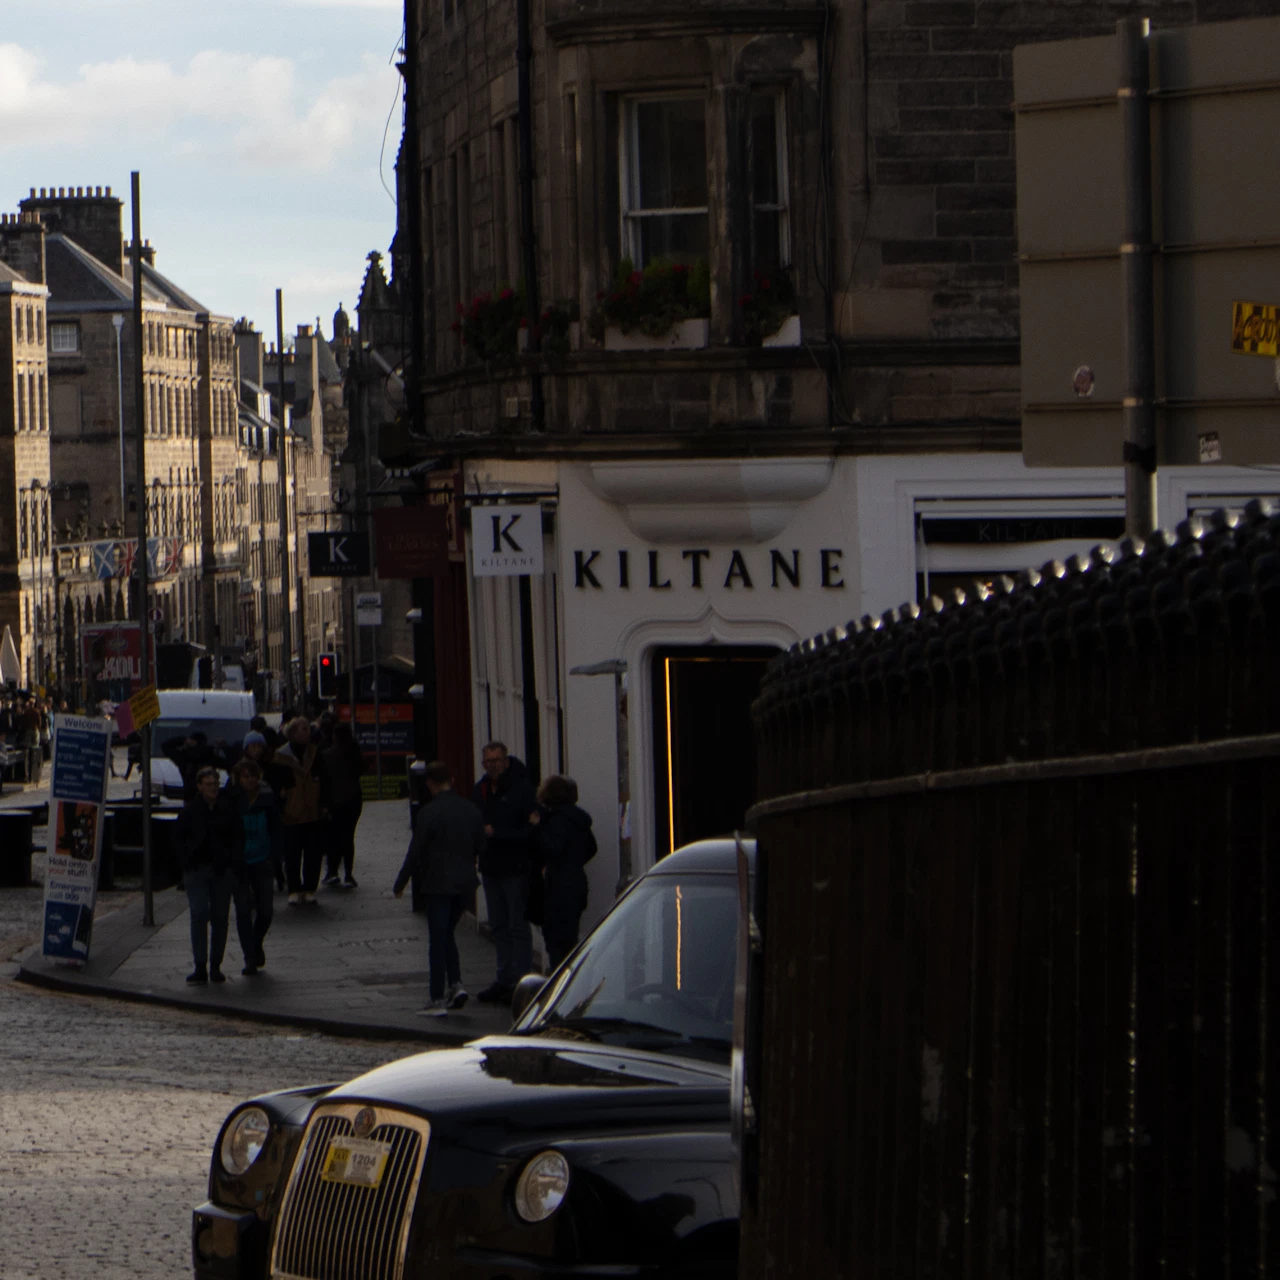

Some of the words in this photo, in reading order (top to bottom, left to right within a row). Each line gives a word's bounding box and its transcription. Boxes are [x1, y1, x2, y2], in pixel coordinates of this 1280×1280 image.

[491, 514, 523, 552] K
[328, 536, 350, 563] K
[481, 557, 535, 567] KILTANE
[574, 549, 845, 589] KILTANE
[49, 856, 67, 867] Hold
[68, 860, 87, 869] onto
[352, 1153, 377, 1166] 1204
